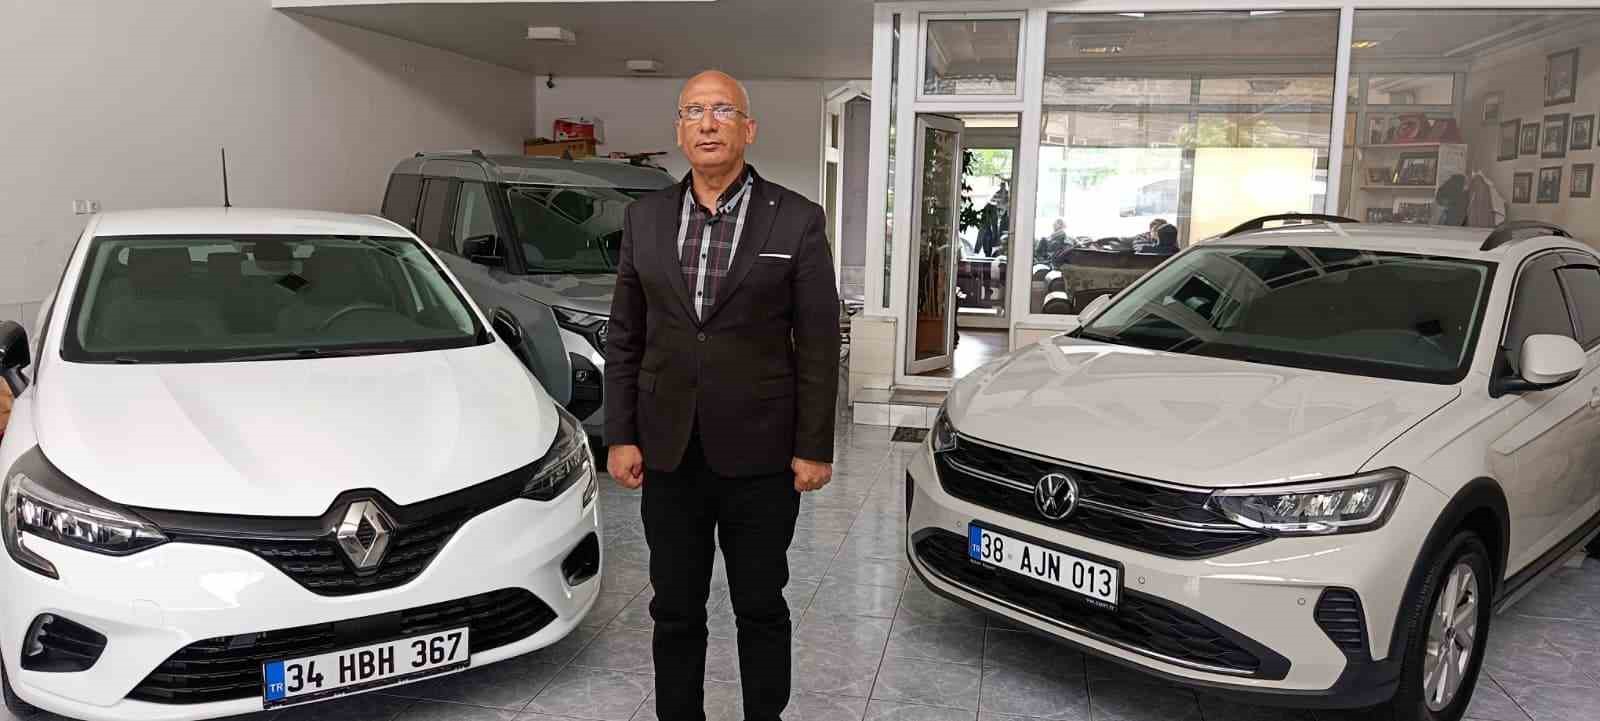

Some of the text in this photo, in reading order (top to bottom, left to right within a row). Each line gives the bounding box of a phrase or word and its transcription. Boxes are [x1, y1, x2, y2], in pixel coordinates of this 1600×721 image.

[981, 533, 1112, 596] 38 AJN 013
[269, 682, 284, 693] TR
[286, 632, 462, 692] 34 HBH 367
